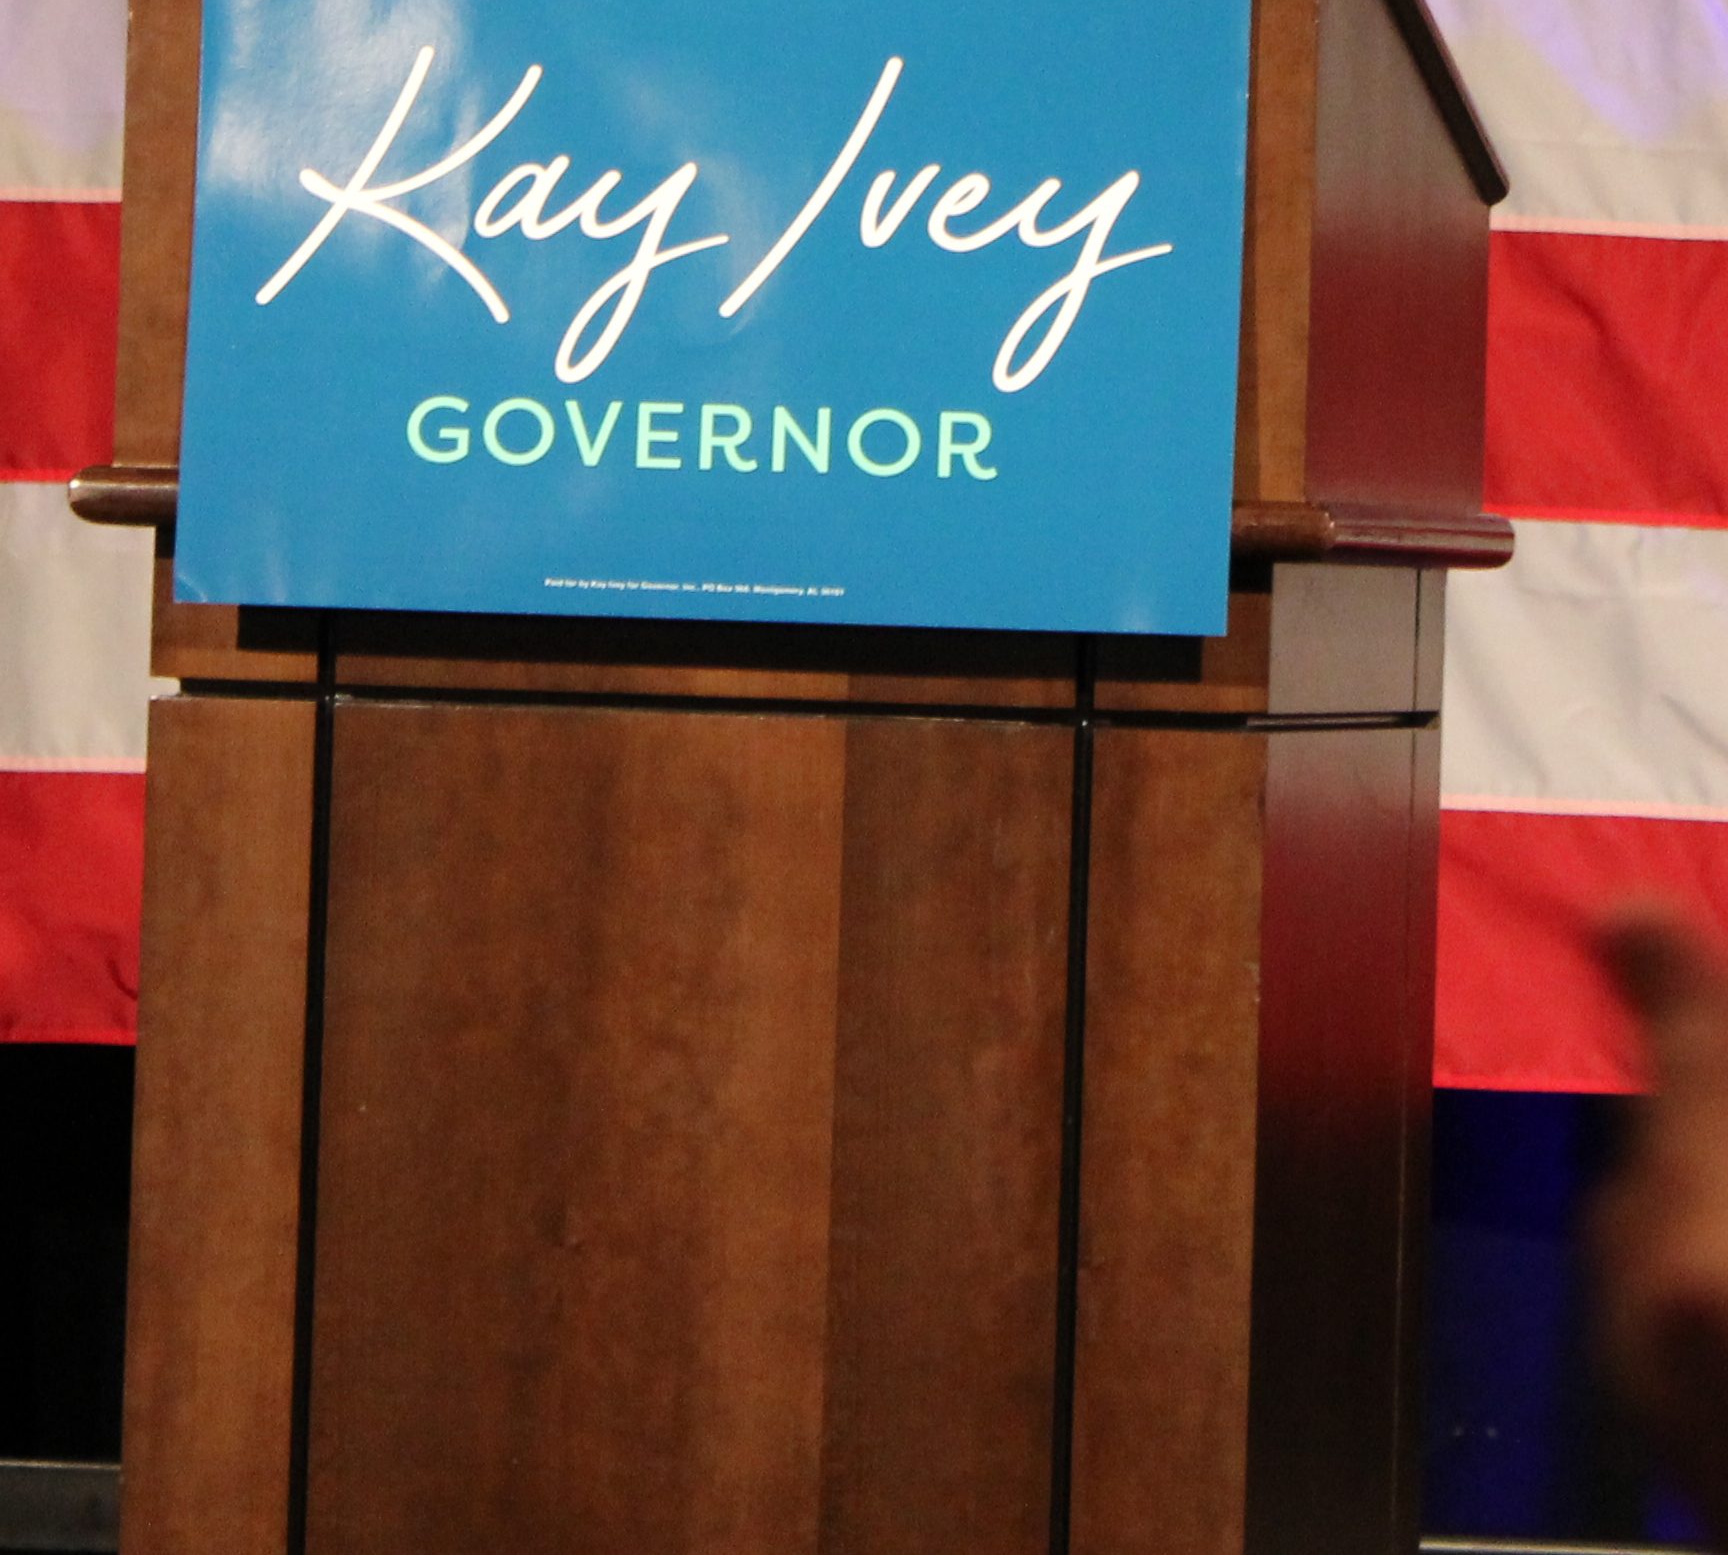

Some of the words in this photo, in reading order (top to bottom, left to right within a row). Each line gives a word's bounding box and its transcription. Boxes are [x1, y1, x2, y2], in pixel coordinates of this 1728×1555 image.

[254, 45, 731, 384] Kay
[717, 55, 1174, 393] Ivey
[405, 395, 998, 481] GOVERNOR
